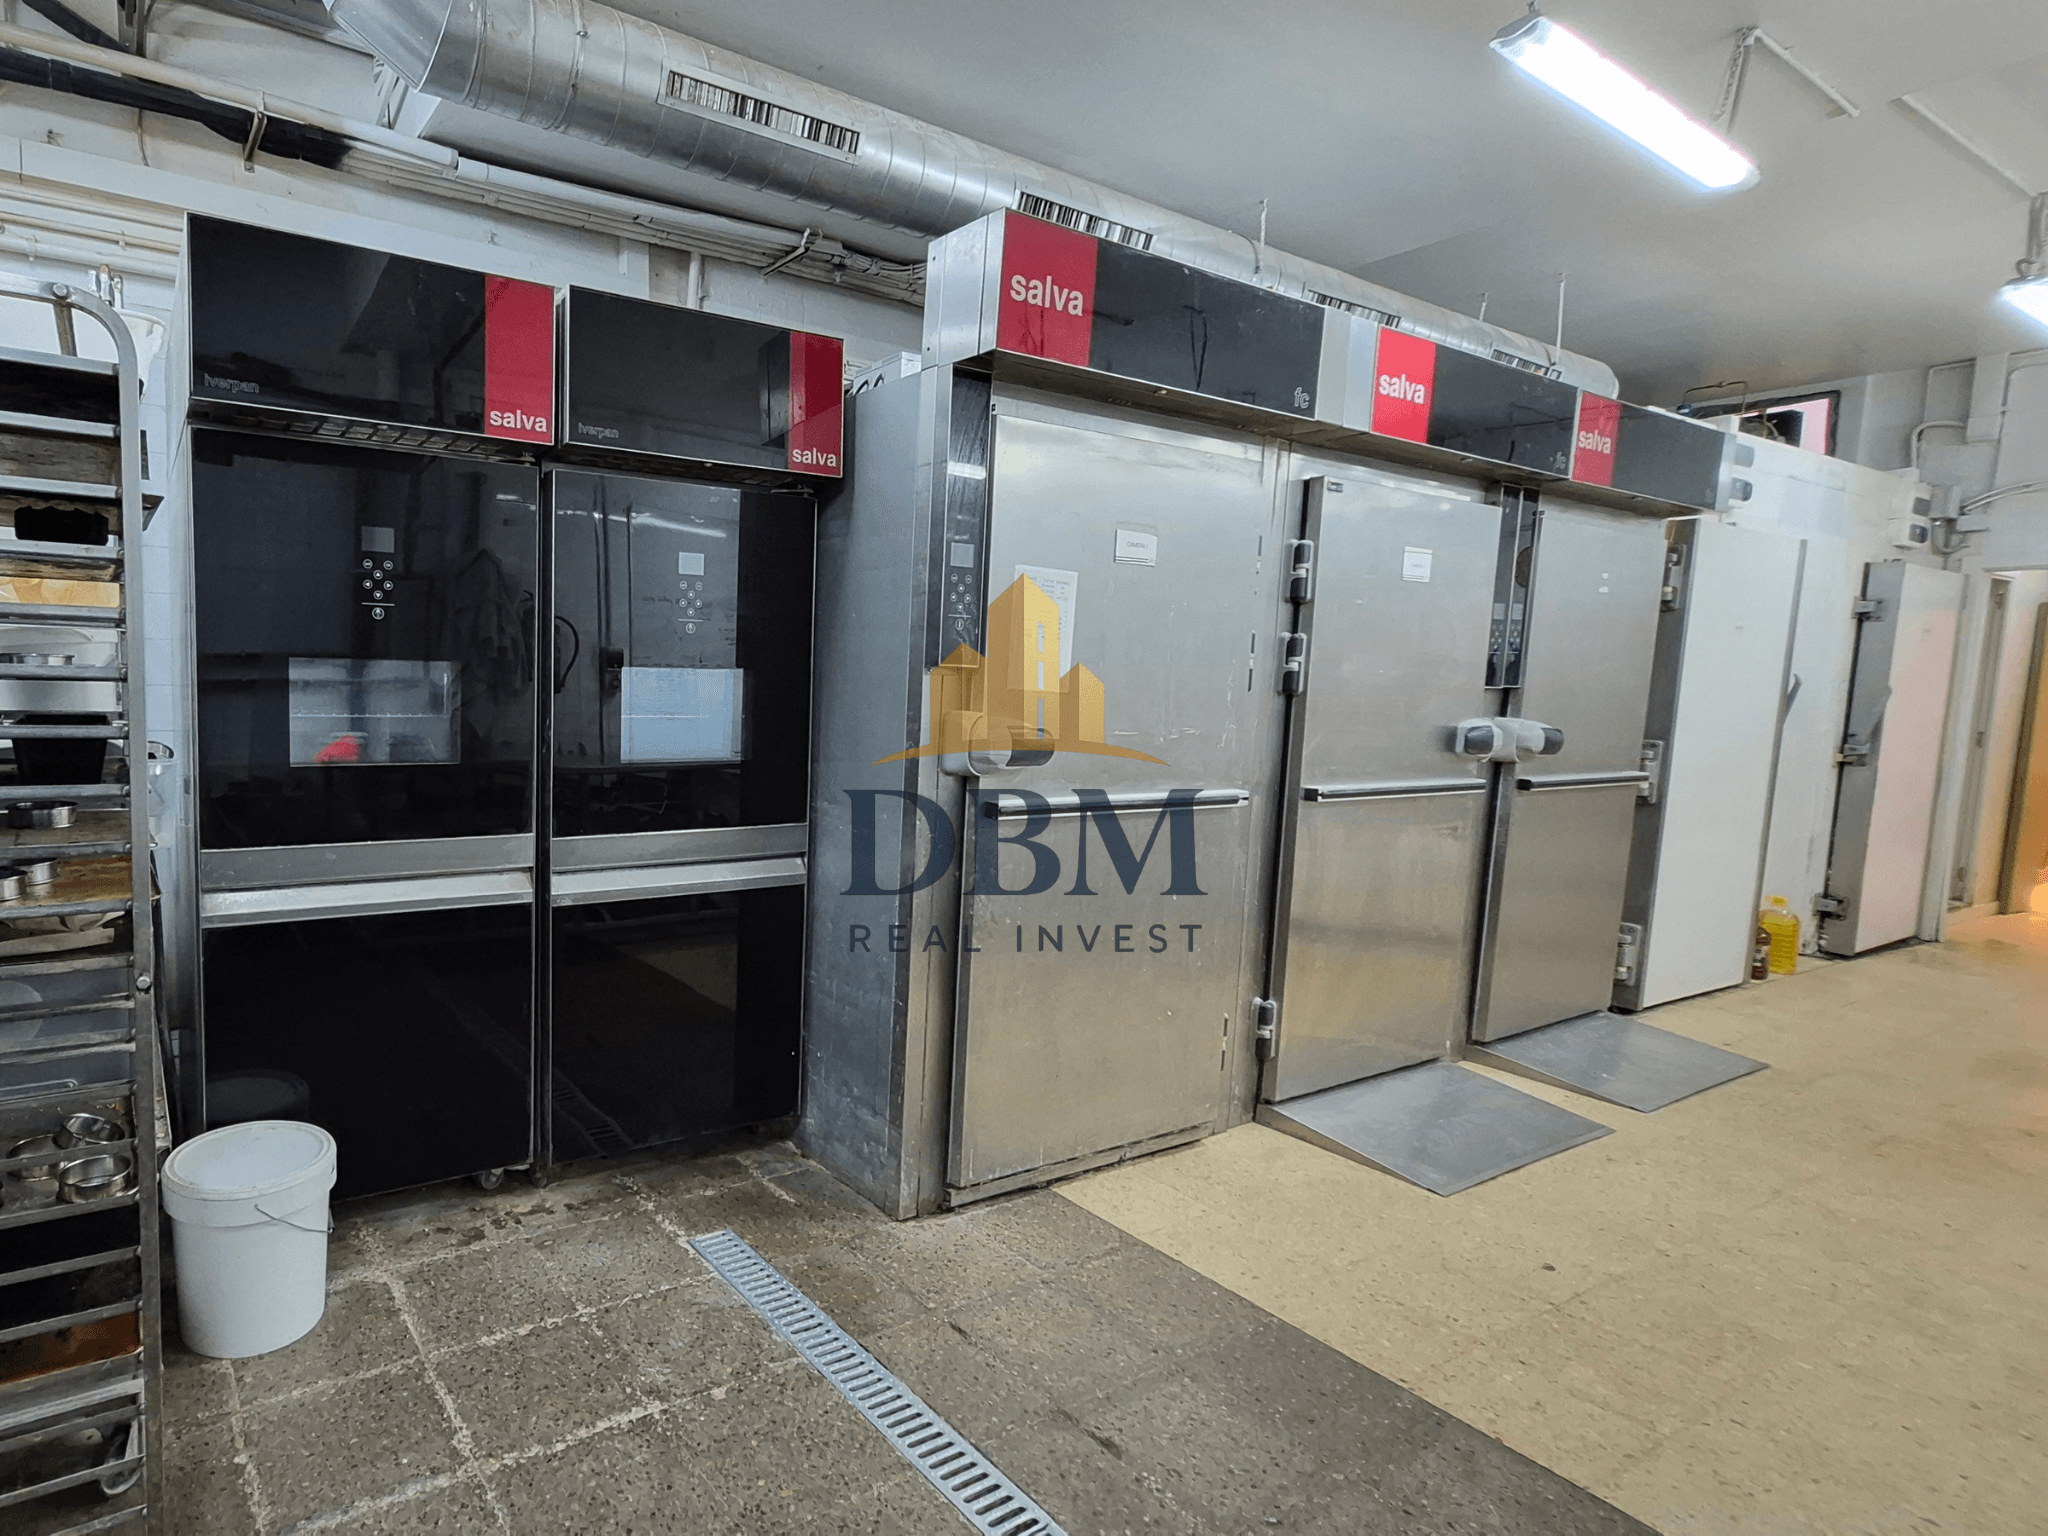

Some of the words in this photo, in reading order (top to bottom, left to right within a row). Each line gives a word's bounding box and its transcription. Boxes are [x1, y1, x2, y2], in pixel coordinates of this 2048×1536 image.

[1010, 274, 1083, 317] salva
[1294, 386, 1310, 409] fc
[1379, 373, 1425, 404] salva
[489, 409, 548, 433] salva
[1578, 429, 1611, 455] salva
[792, 446, 837, 468] salva
